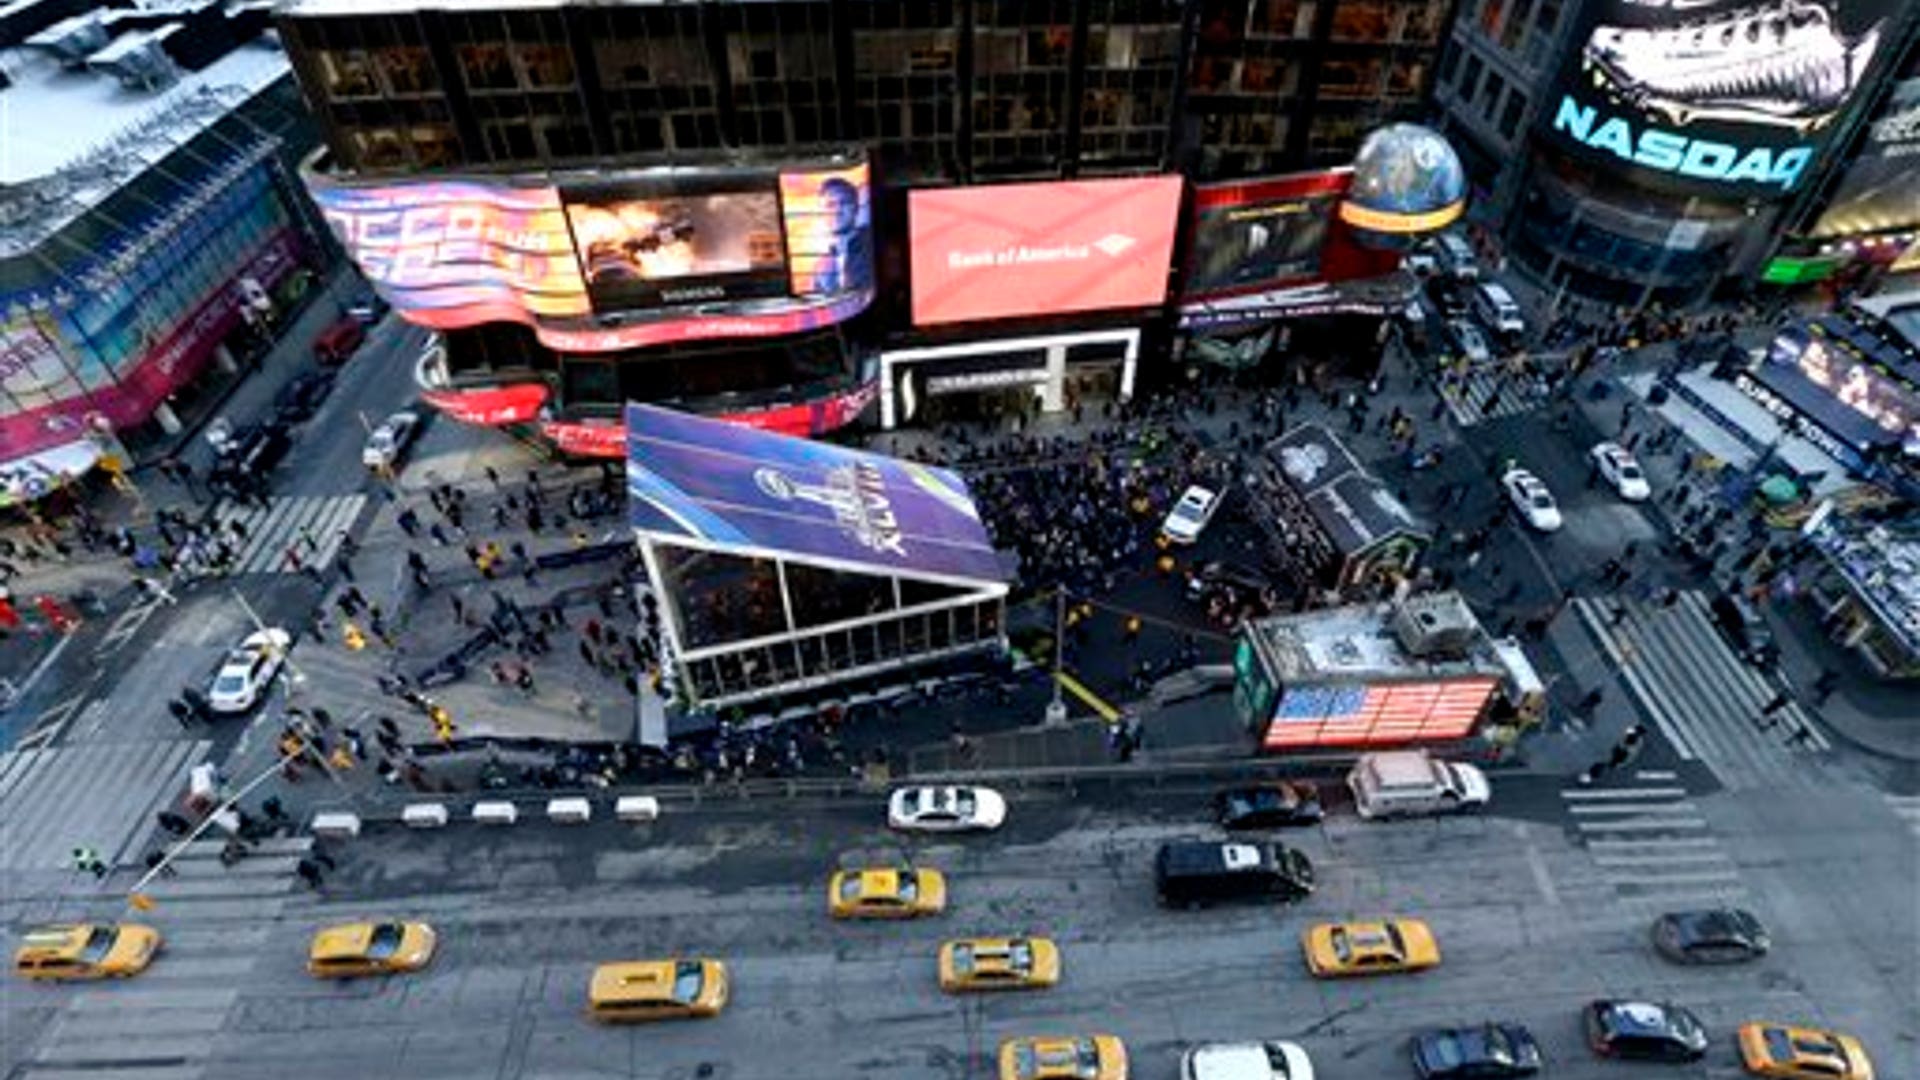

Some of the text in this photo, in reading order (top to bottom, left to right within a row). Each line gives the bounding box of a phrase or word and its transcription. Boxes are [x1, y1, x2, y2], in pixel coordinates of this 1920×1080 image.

[1553, 94, 1812, 191] NASDAQ
[948, 245, 1087, 268] Bank of America
[1736, 374, 1794, 419] SUPER
